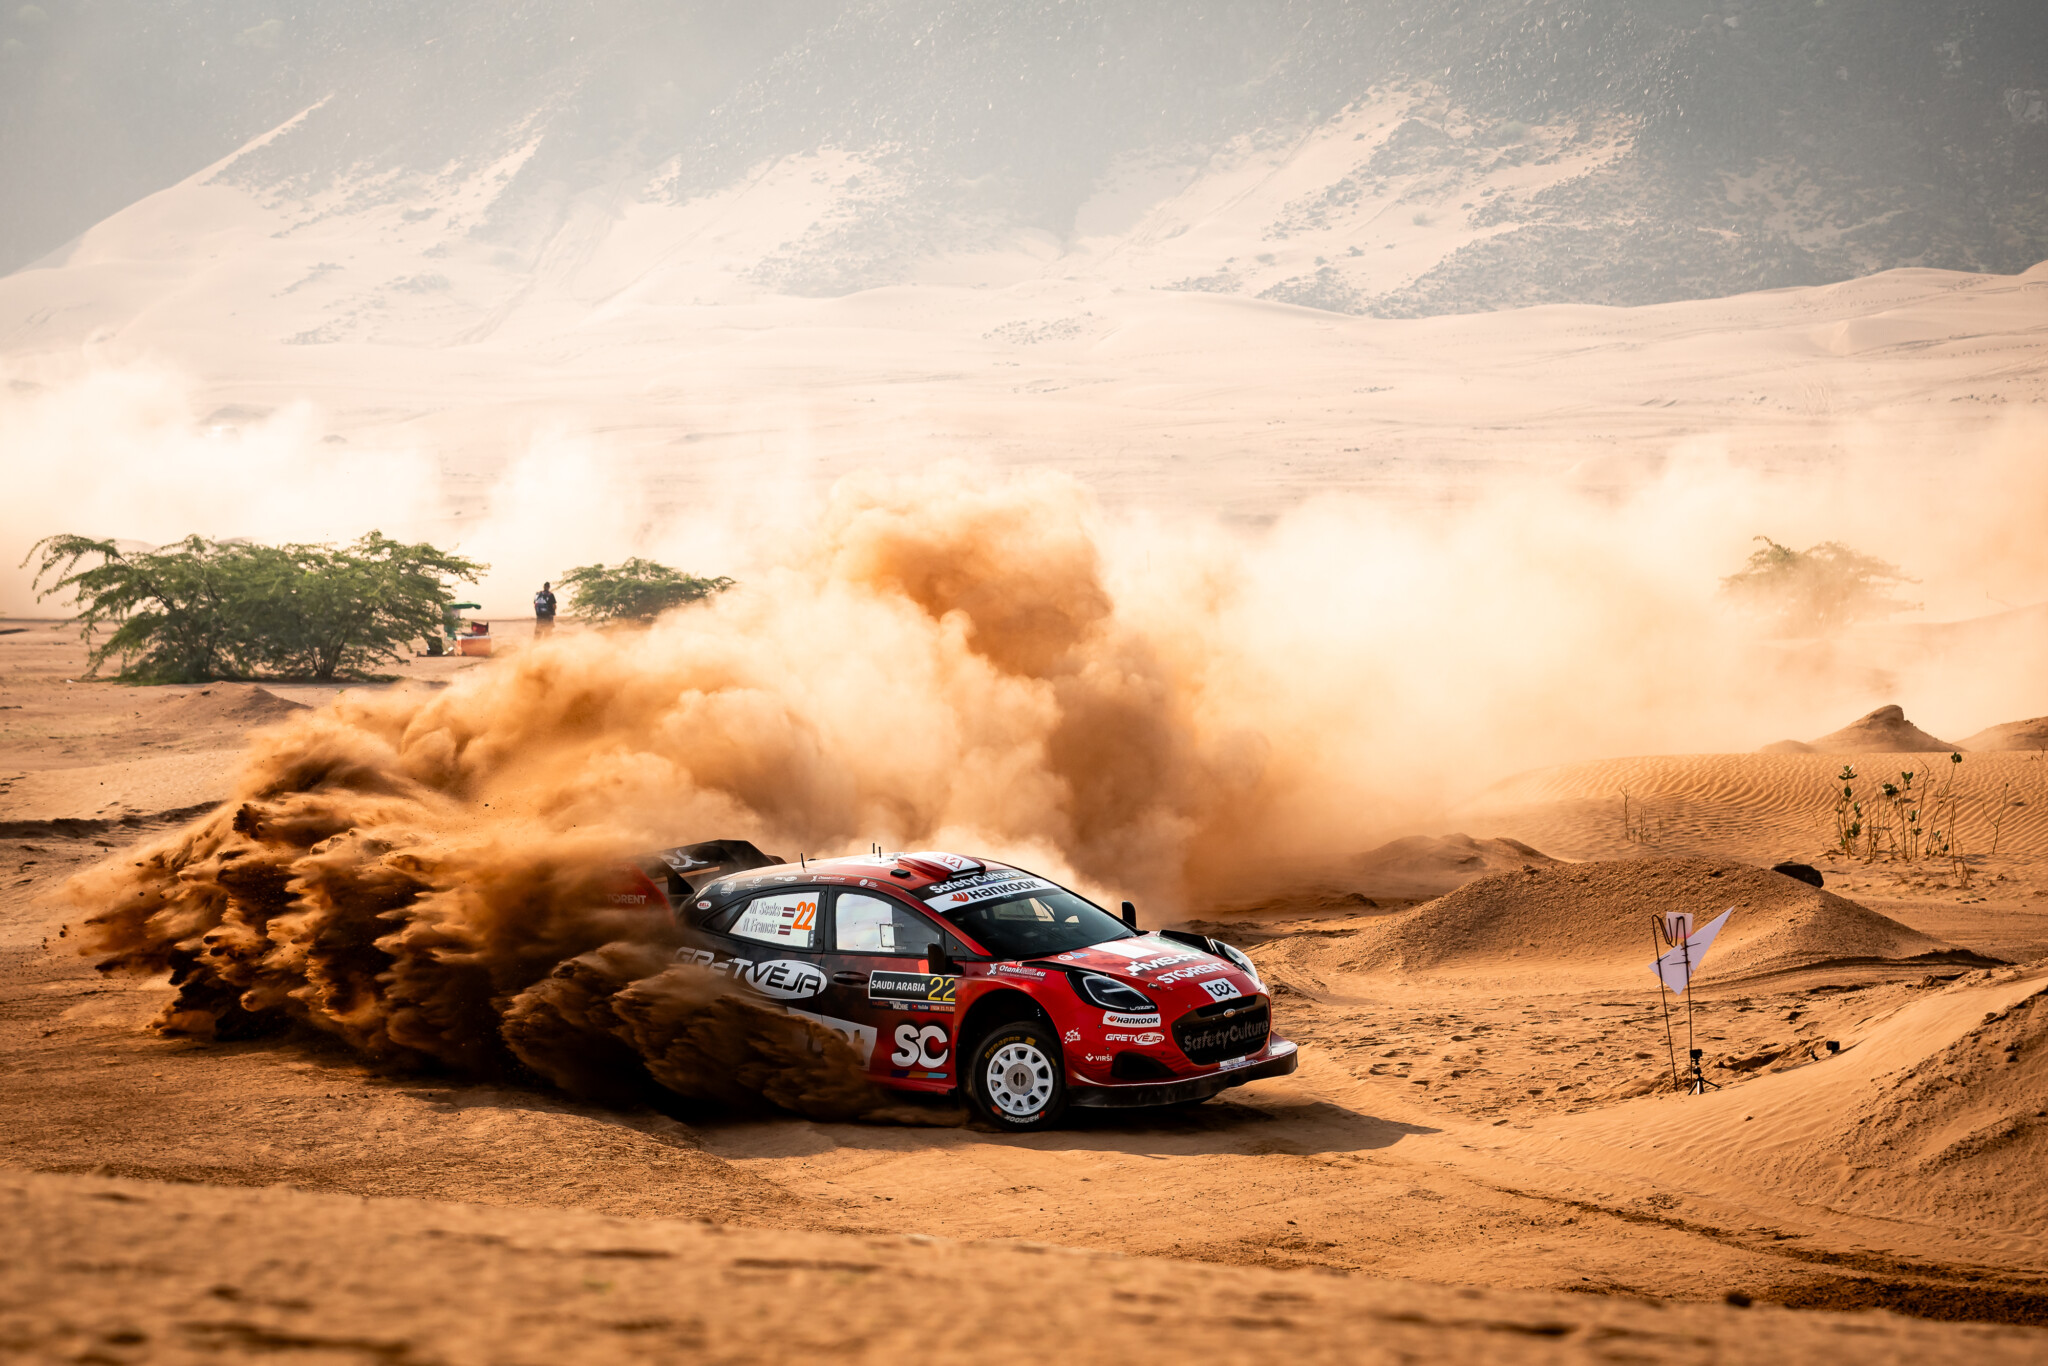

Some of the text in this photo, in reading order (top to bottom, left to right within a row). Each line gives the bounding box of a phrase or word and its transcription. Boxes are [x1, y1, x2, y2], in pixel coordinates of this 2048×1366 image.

[928, 871, 1021, 894] SafetyCulture
[750, 918, 779, 936] Francis
[792, 901, 816, 931] 22
[1156, 963, 1230, 985] STORENT
[871, 980, 926, 992] SAUDI ARABIA
[928, 976, 955, 1001] 22
[1206, 981, 1237, 997] tet
[891, 1024, 949, 1069] SC
[984, 1036, 1021, 1059] Dynapro
[1184, 1020, 1269, 1052] SafetyCulture
[1095, 1054, 1113, 1062] VIRŠI
